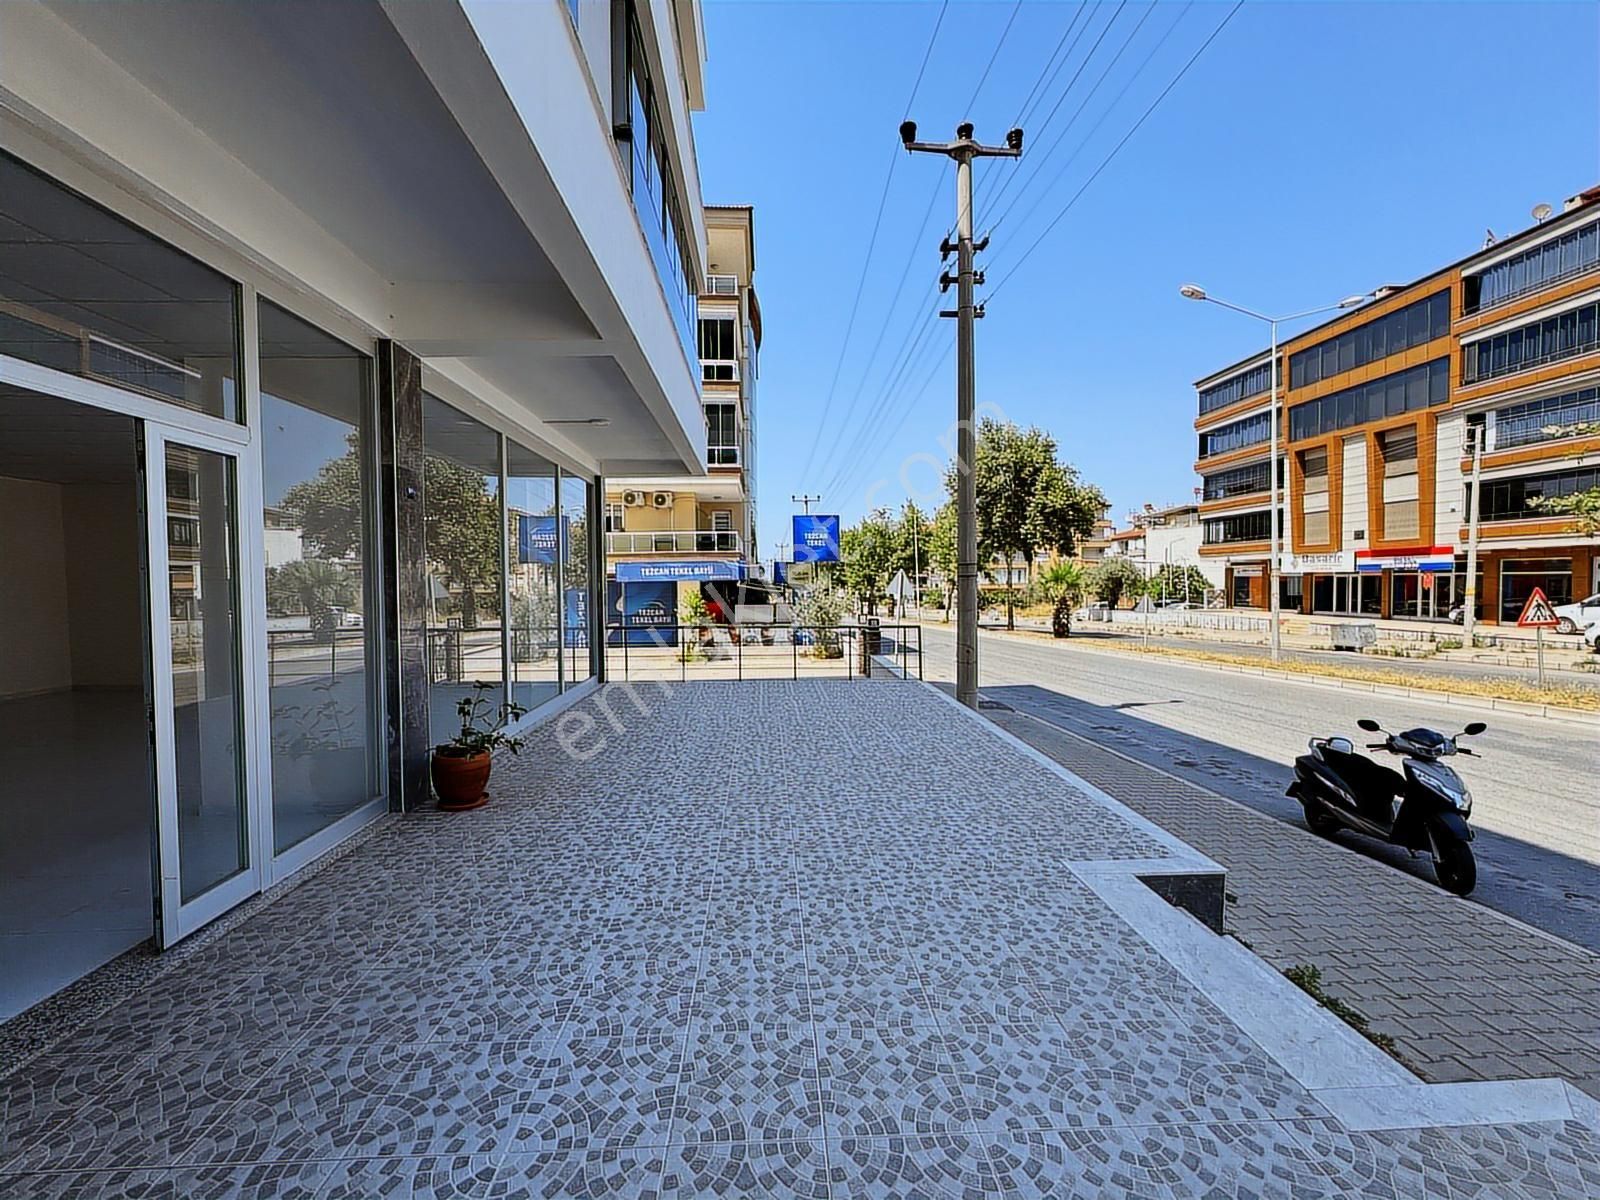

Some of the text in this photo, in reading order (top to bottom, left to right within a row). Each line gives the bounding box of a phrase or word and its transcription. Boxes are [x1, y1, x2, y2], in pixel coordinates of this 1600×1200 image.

[804, 532, 828, 540] TEZCAN
[641, 567, 669, 577] TEZCAN
[670, 567, 693, 576] TEKEL
[639, 608, 665, 617] TEZCAN
[631, 616, 653, 625] TEKEL
